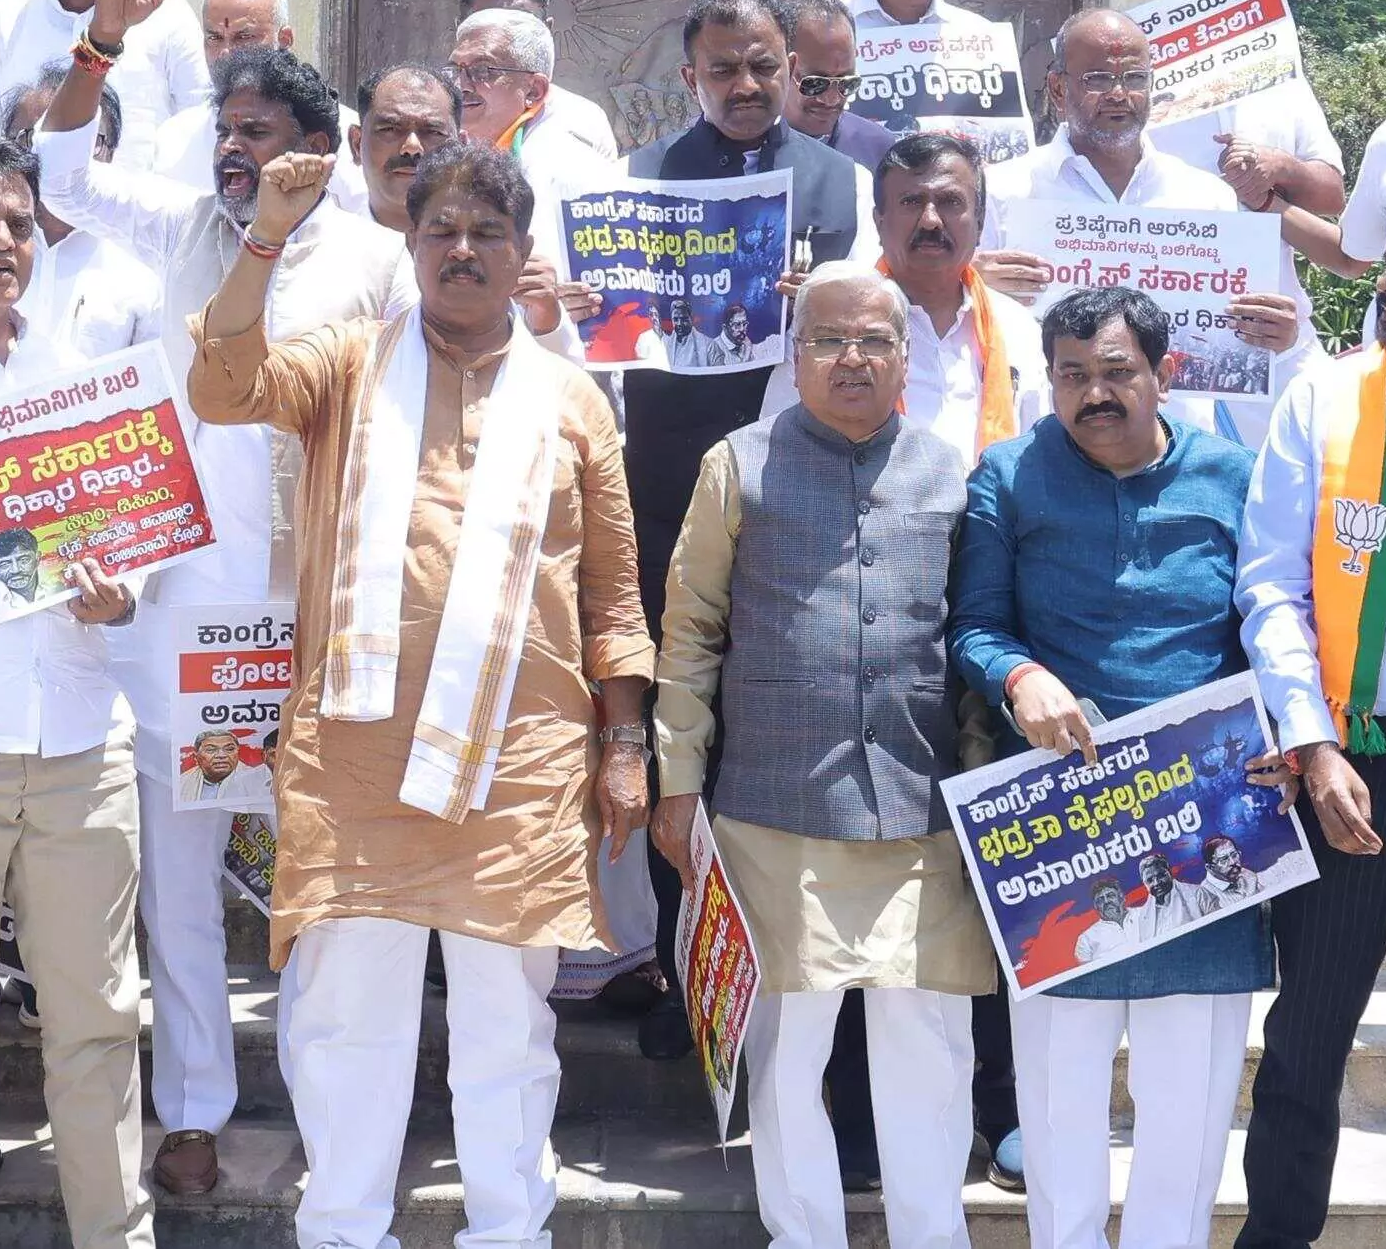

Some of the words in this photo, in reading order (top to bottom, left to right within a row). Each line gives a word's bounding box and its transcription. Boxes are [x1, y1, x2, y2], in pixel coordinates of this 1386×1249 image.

[573, 224, 636, 258] ಭದ್ರತಾ
[691, 268, 732, 296] ಬಲಿ
[103, 366, 140, 396] ಬಲಿ
[28, 410, 174, 483] ಸರ್ಕಾರಕ್ಕೆ
[2, 479, 77, 522] ಧಿಕ್ಕಾರ
[968, 776, 1055, 823] ಕಾಂಗ್ರೆಸ್
[1058, 738, 1151, 791] ಸರ್ಕಾರದ
[978, 810, 1063, 867] ಭದ್ರತಾ
[1064, 753, 1196, 839] ವೈಫಲ್ಯದಿಂದ
[996, 825, 1152, 906] ಅಮಾಯಕರು
[1157, 799, 1202, 844] ಬಲಿ
